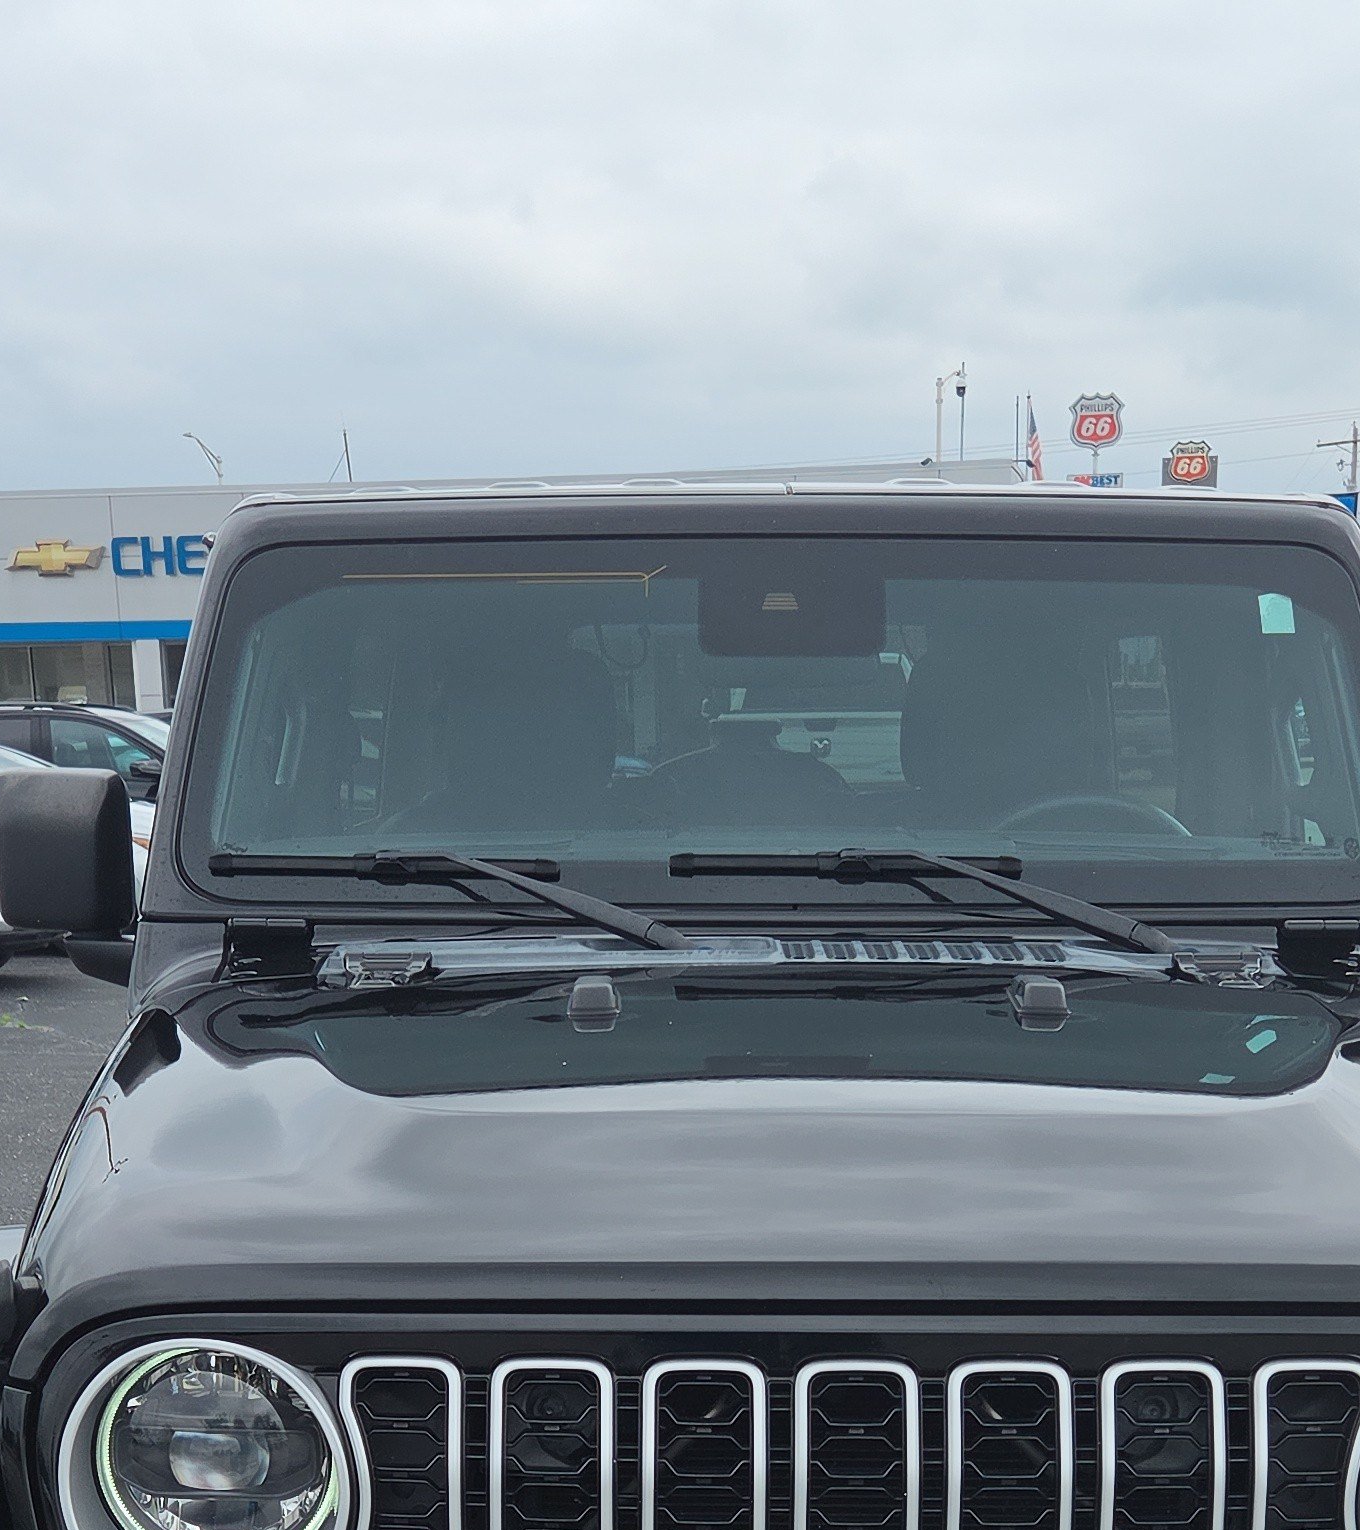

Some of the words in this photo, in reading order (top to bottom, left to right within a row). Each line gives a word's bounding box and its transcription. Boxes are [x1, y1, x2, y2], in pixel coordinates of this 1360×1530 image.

[1080, 402, 1115, 413] PHILLIPS
[1080, 417, 1112, 437] 66
[1176, 457, 1204, 475] 66
